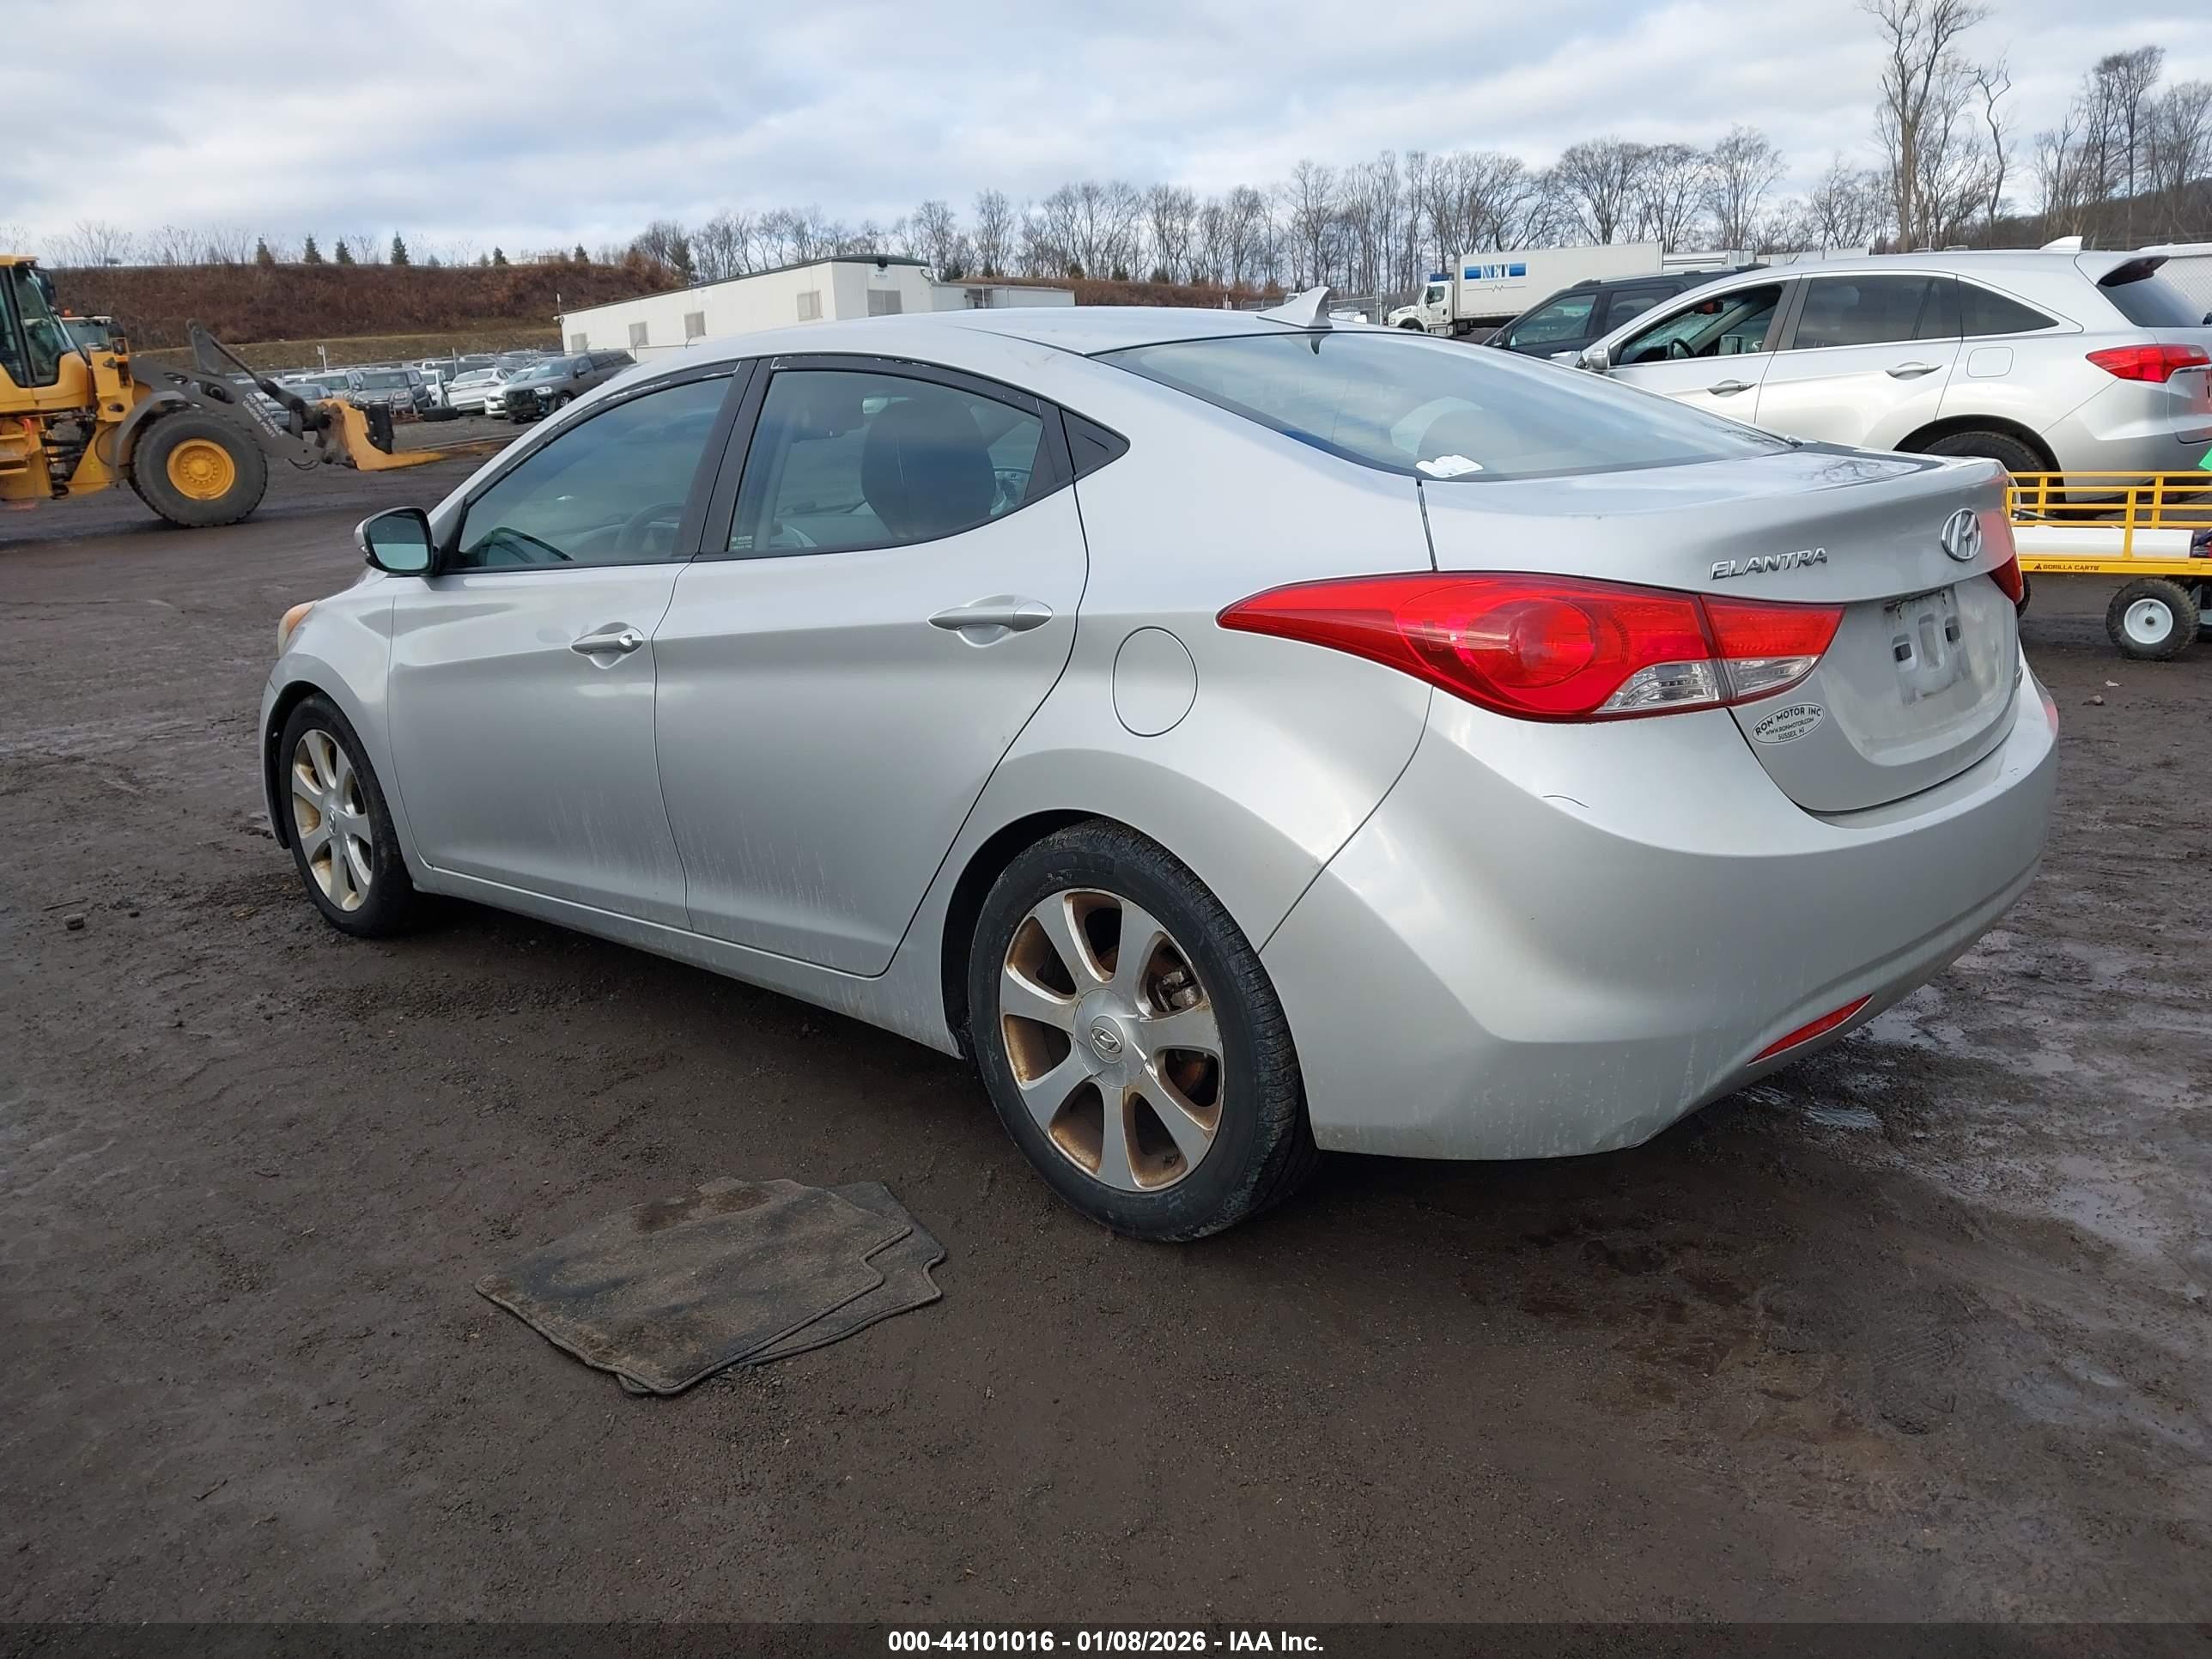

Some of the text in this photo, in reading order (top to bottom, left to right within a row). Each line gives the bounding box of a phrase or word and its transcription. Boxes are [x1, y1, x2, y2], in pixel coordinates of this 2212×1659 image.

[1481, 264, 1510, 279] NET
[242, 400, 262, 422] UNDER
[246, 392, 283, 436] DO NOT WALK
[1711, 547, 1828, 580] ELANTRA
[1755, 707, 1821, 736] RON MOTOR INC
